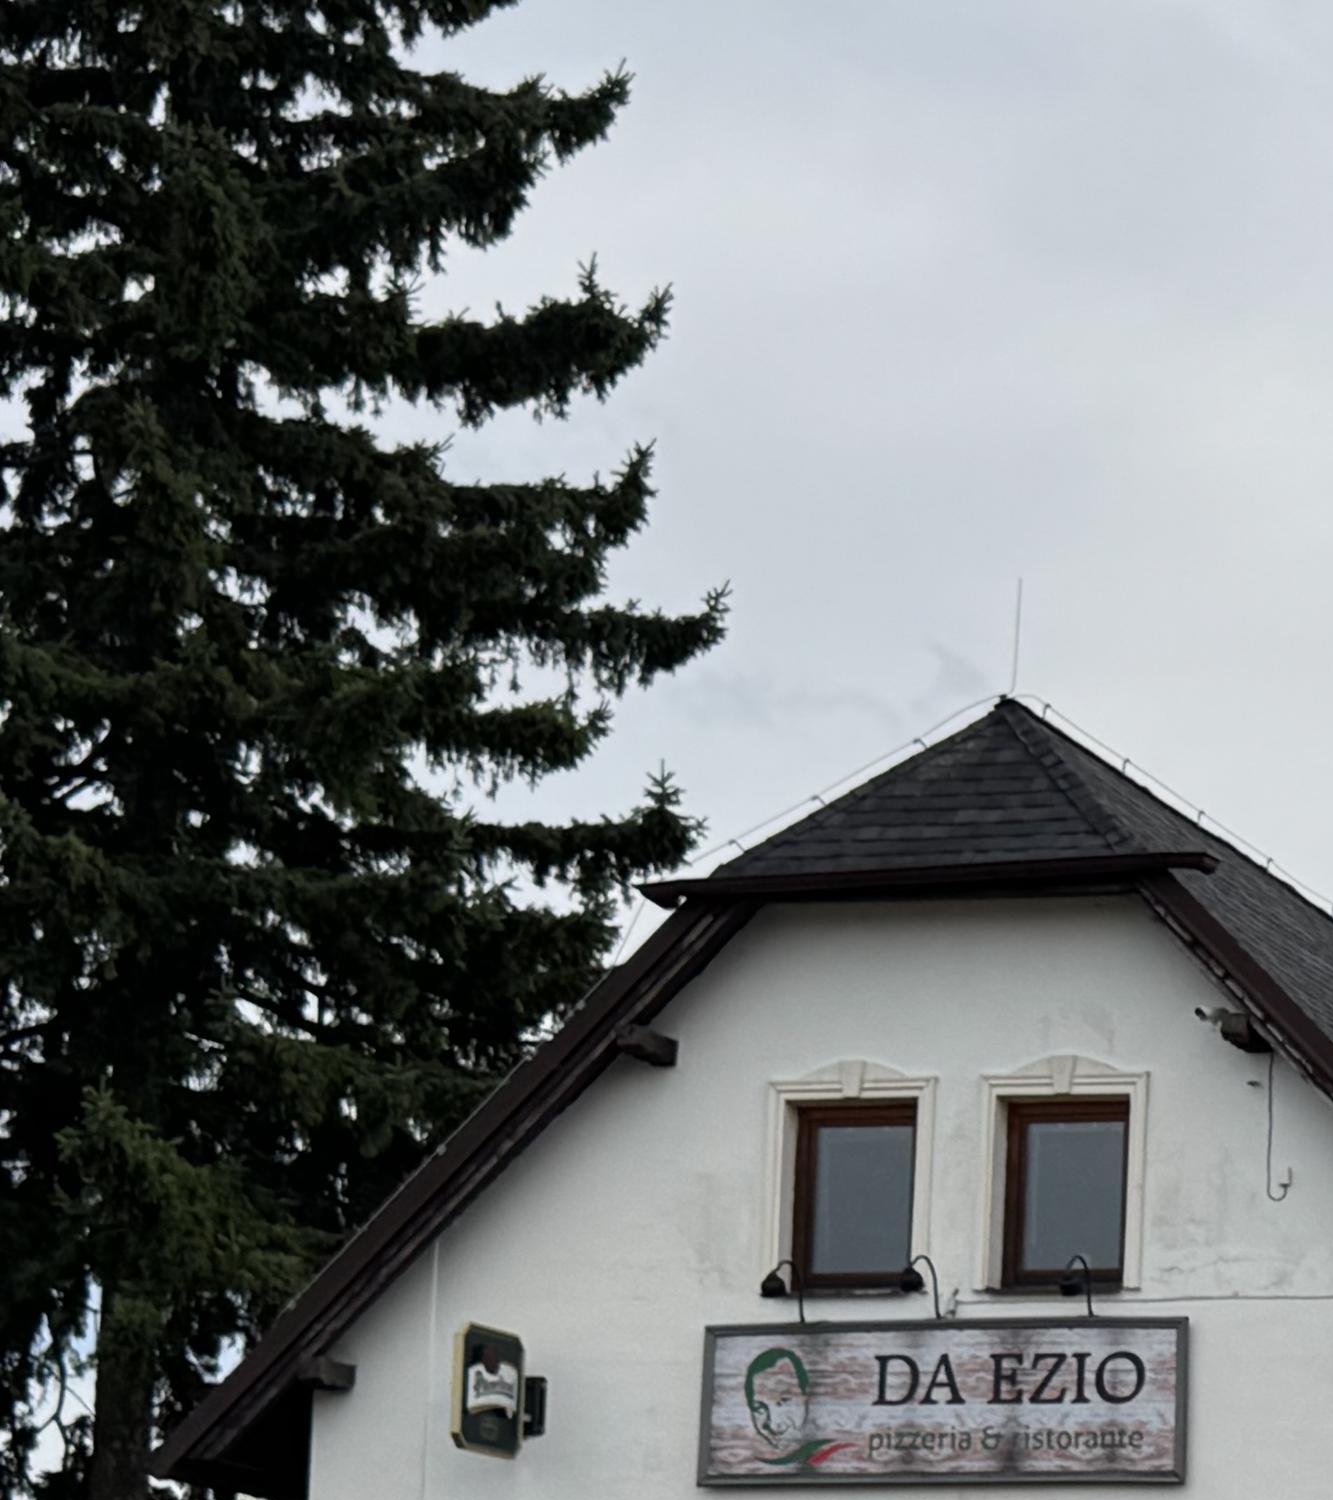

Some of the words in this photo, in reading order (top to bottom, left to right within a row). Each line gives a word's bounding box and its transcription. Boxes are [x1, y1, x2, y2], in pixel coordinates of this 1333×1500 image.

[872, 1353, 966, 1407] DA
[987, 1350, 1146, 1405] EZIO
[868, 1427, 972, 1459] pizzeria
[980, 1426, 1001, 1450] &
[1012, 1426, 1144, 1450] ristorante
